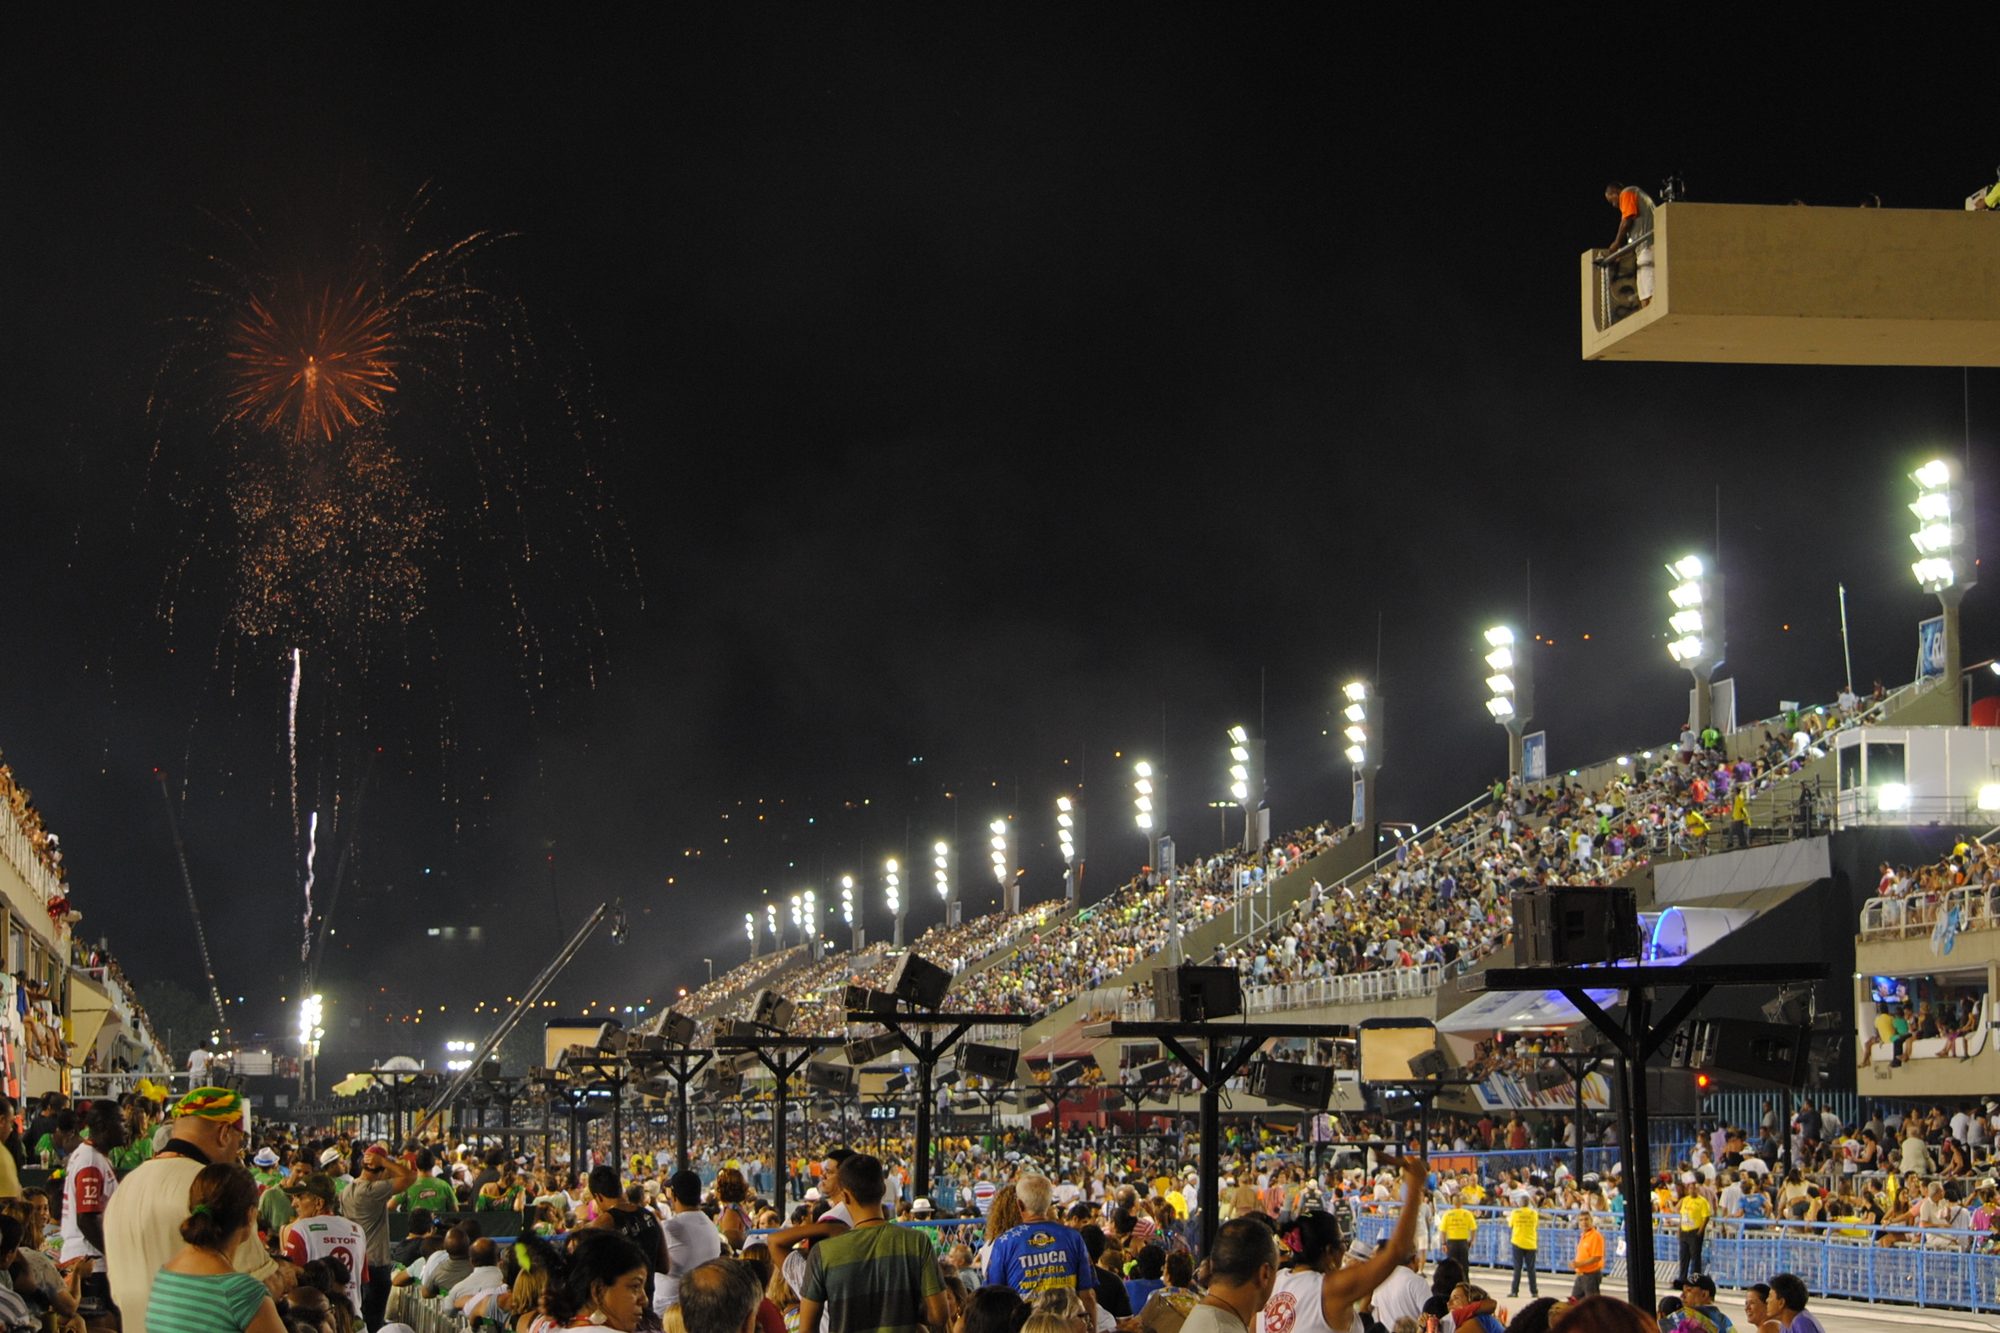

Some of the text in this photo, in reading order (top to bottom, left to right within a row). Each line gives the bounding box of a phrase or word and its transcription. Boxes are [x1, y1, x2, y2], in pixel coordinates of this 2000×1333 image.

[84, 1185, 98, 1199] 12
[323, 1236, 356, 1244] SETOR
[1019, 1250, 1067, 1268] TIJUCA
[1024, 1265, 1066, 1278] BATERIA
